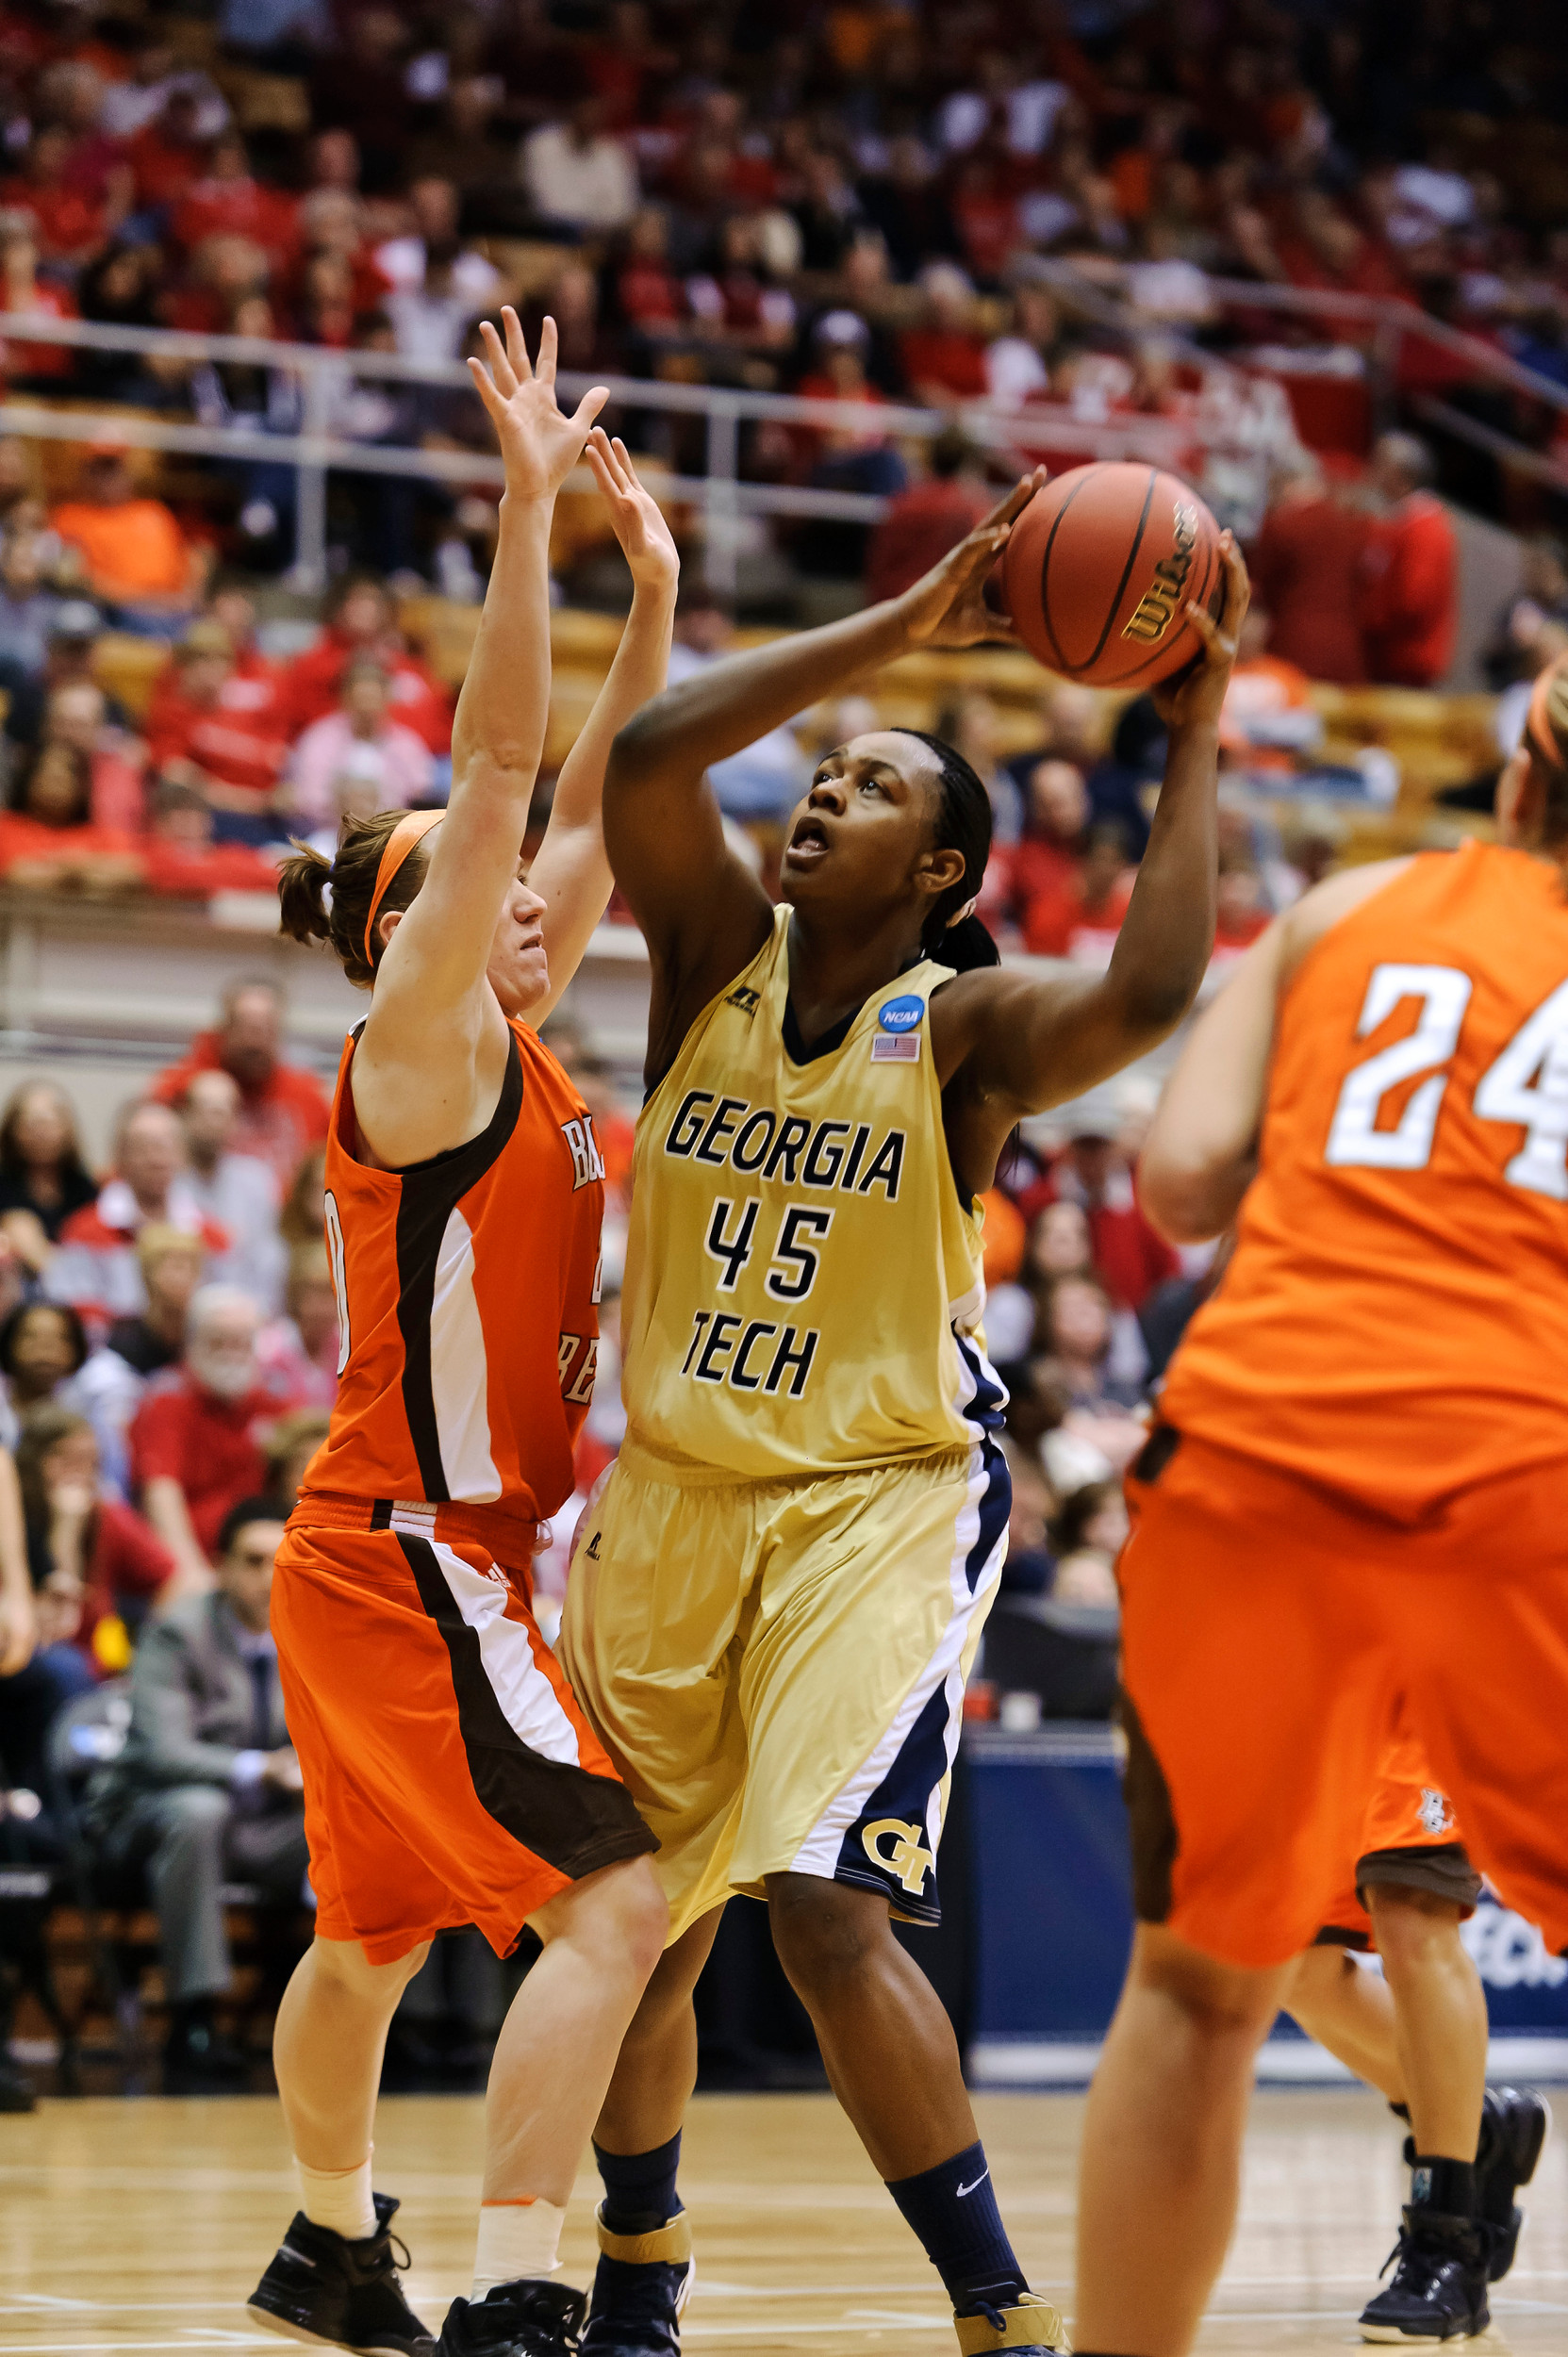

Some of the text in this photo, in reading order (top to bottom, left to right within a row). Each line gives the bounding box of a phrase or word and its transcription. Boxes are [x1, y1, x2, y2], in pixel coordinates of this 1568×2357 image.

[883, 1011, 919, 1024] NCAA
[1325, 963, 1568, 1203] 24
[664, 1088, 908, 1203] GEORGIA
[703, 1196, 836, 1304] 45
[679, 1309, 821, 1399] TECH
[862, 1819, 933, 1896] GT
